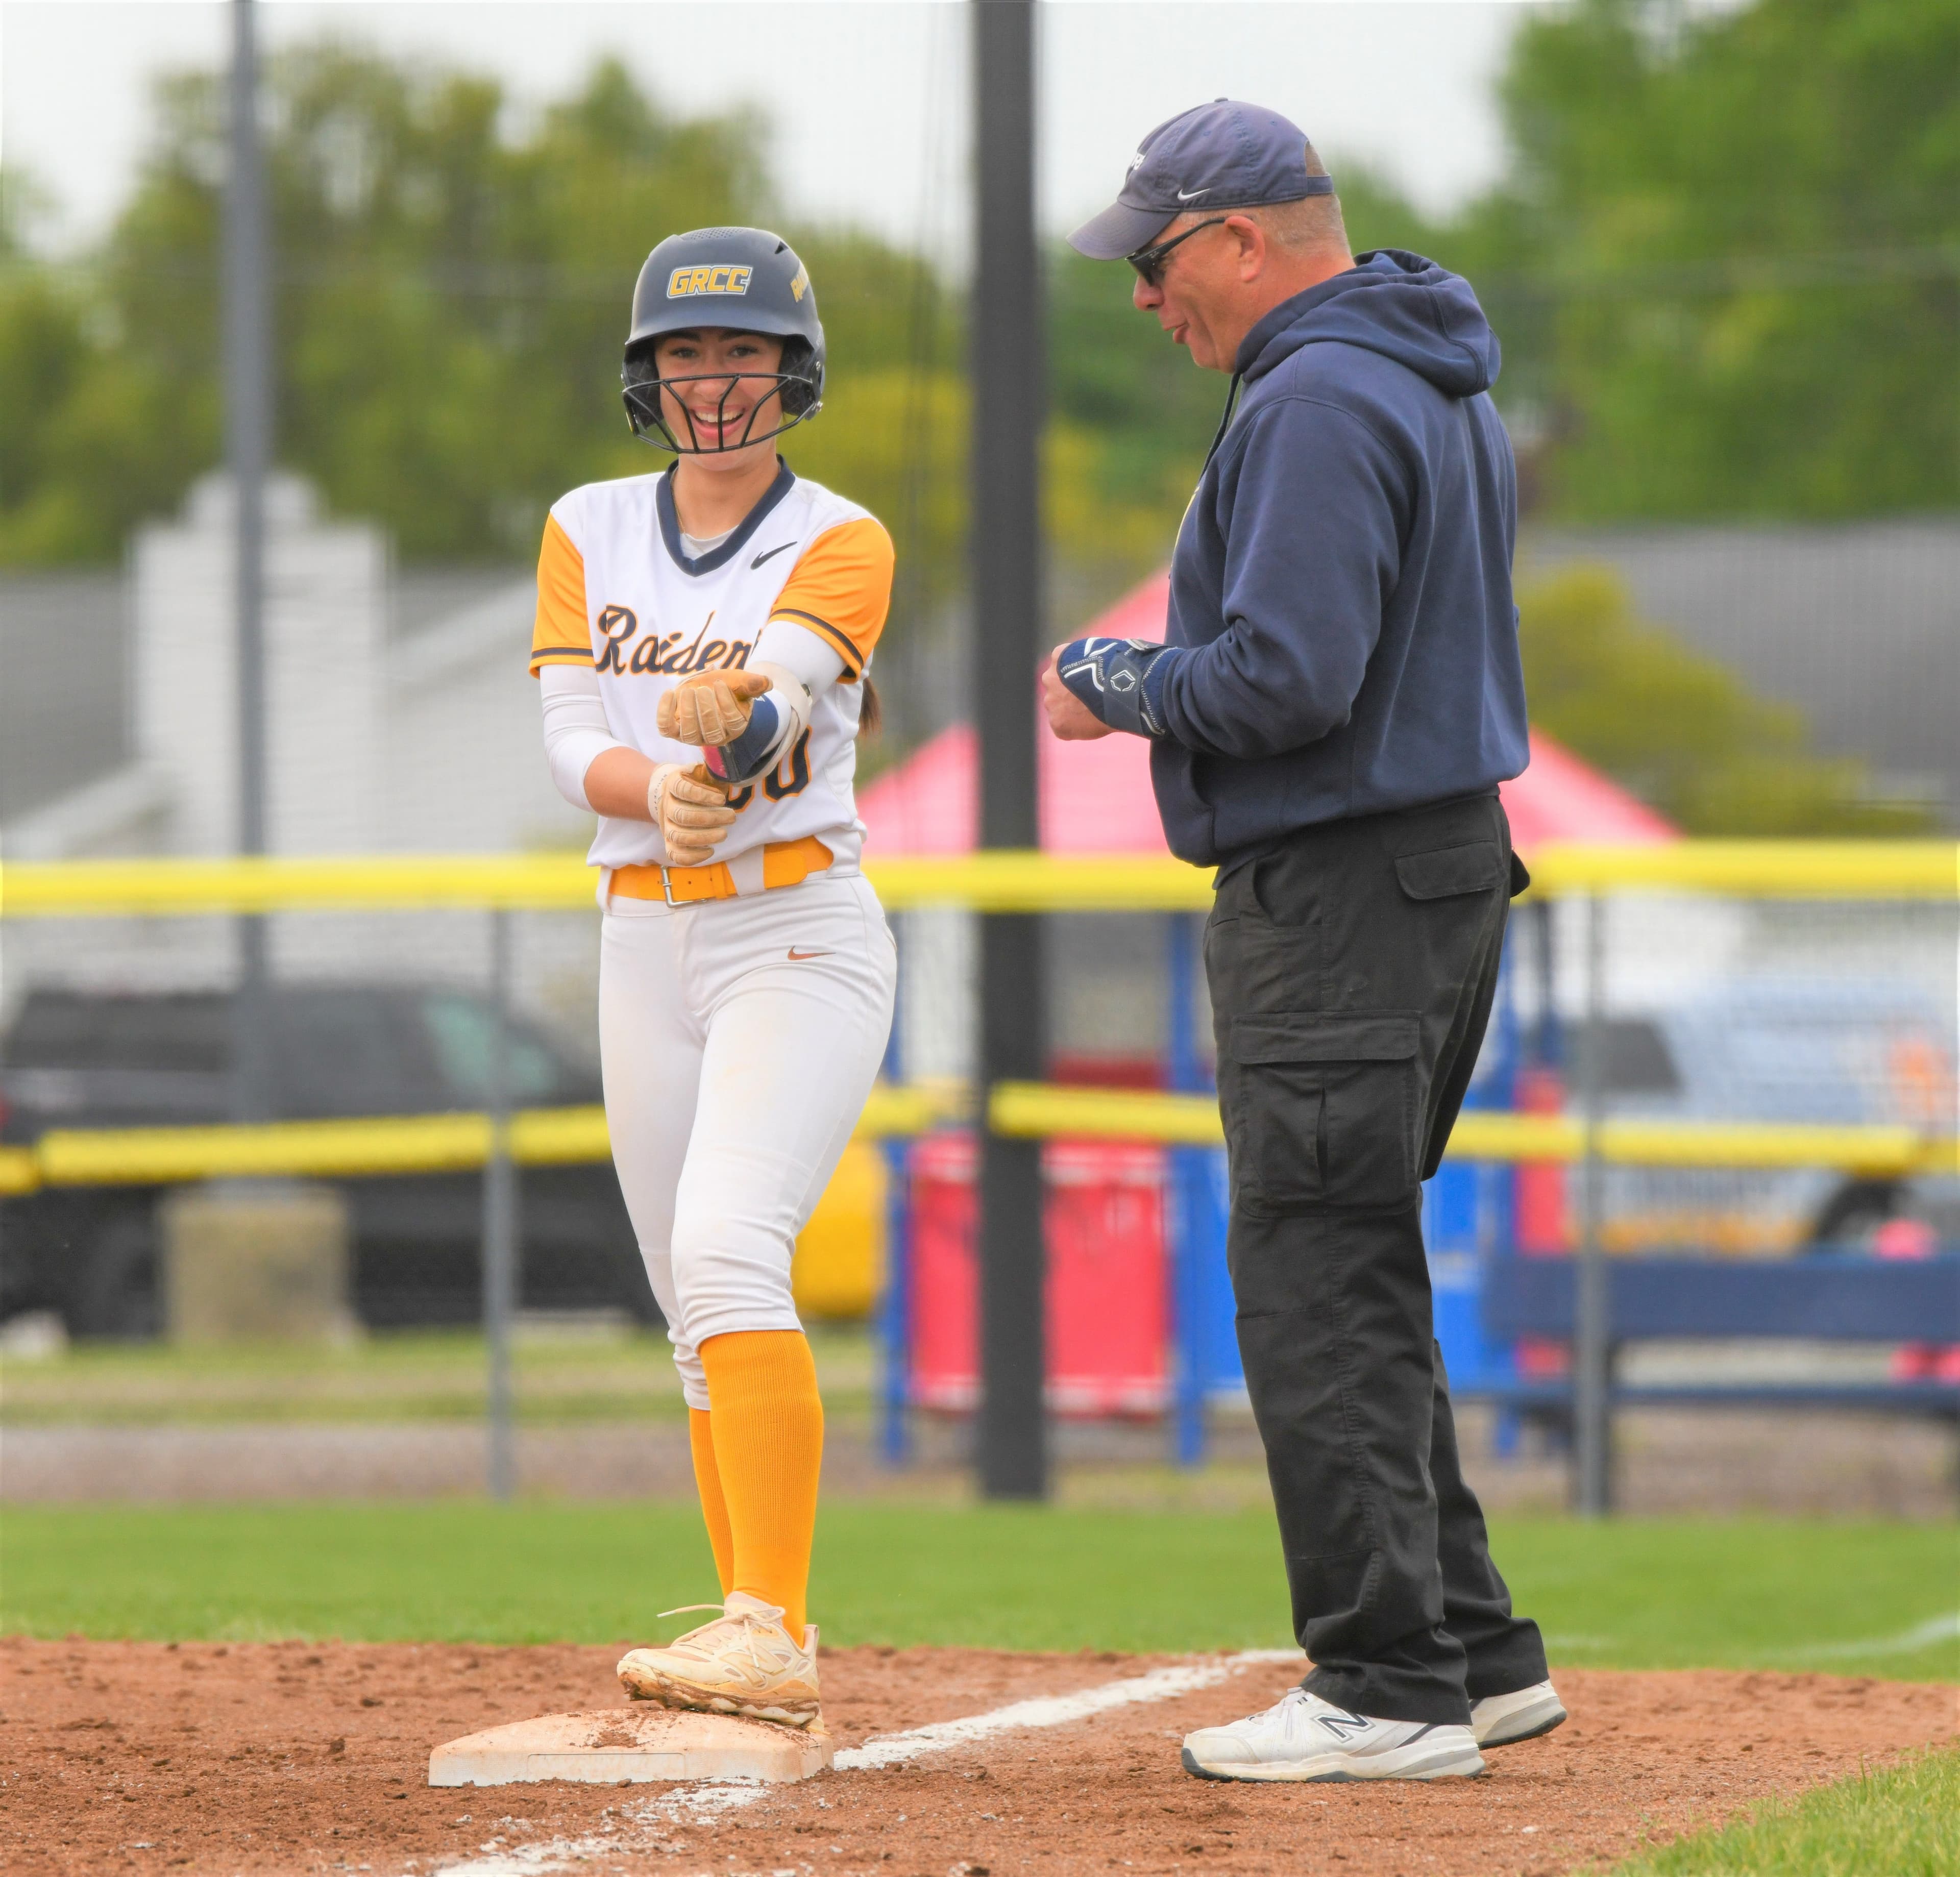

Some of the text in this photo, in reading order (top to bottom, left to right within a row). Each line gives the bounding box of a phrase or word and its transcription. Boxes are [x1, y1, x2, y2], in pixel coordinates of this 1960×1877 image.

[668, 266, 751, 297] GRCC
[596, 604, 763, 677] Raider
[1313, 1711, 1373, 1741] N
